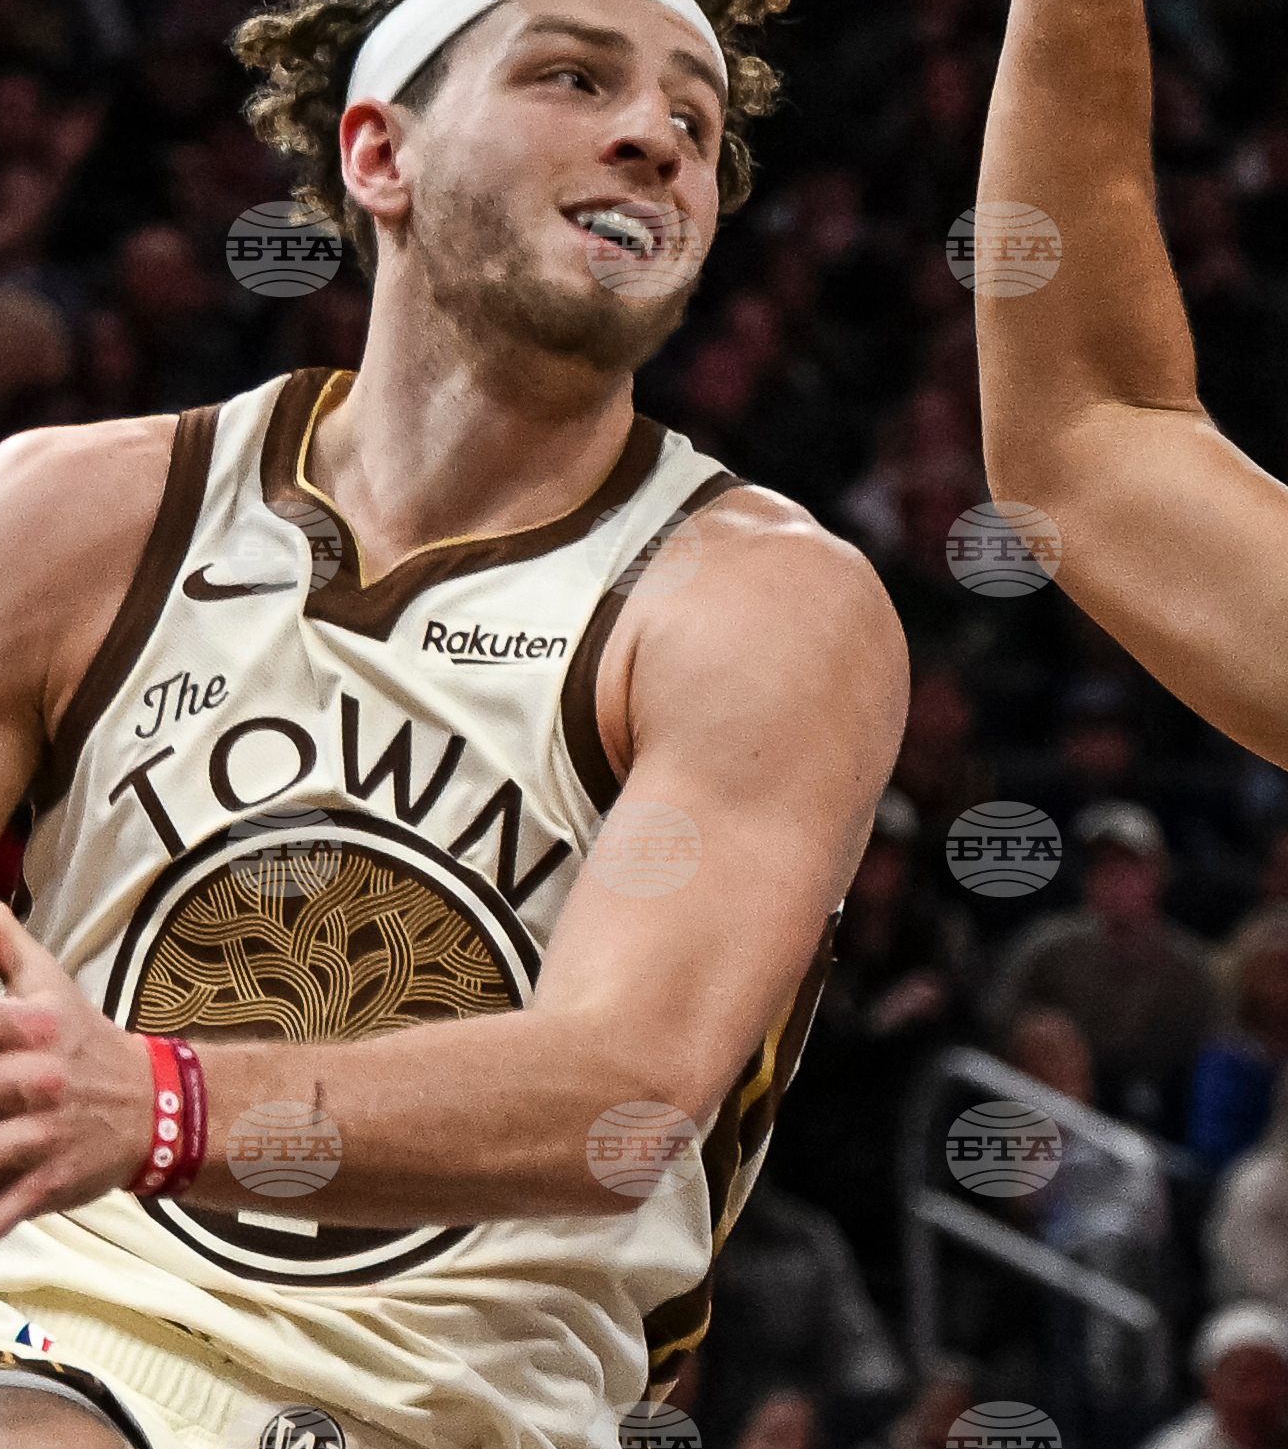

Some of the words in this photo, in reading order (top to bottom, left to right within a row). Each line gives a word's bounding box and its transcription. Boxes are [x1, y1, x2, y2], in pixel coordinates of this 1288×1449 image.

[422, 620, 568, 660] Rakuten
[135, 670, 229, 739] The
[110, 691, 572, 910] TOWN
